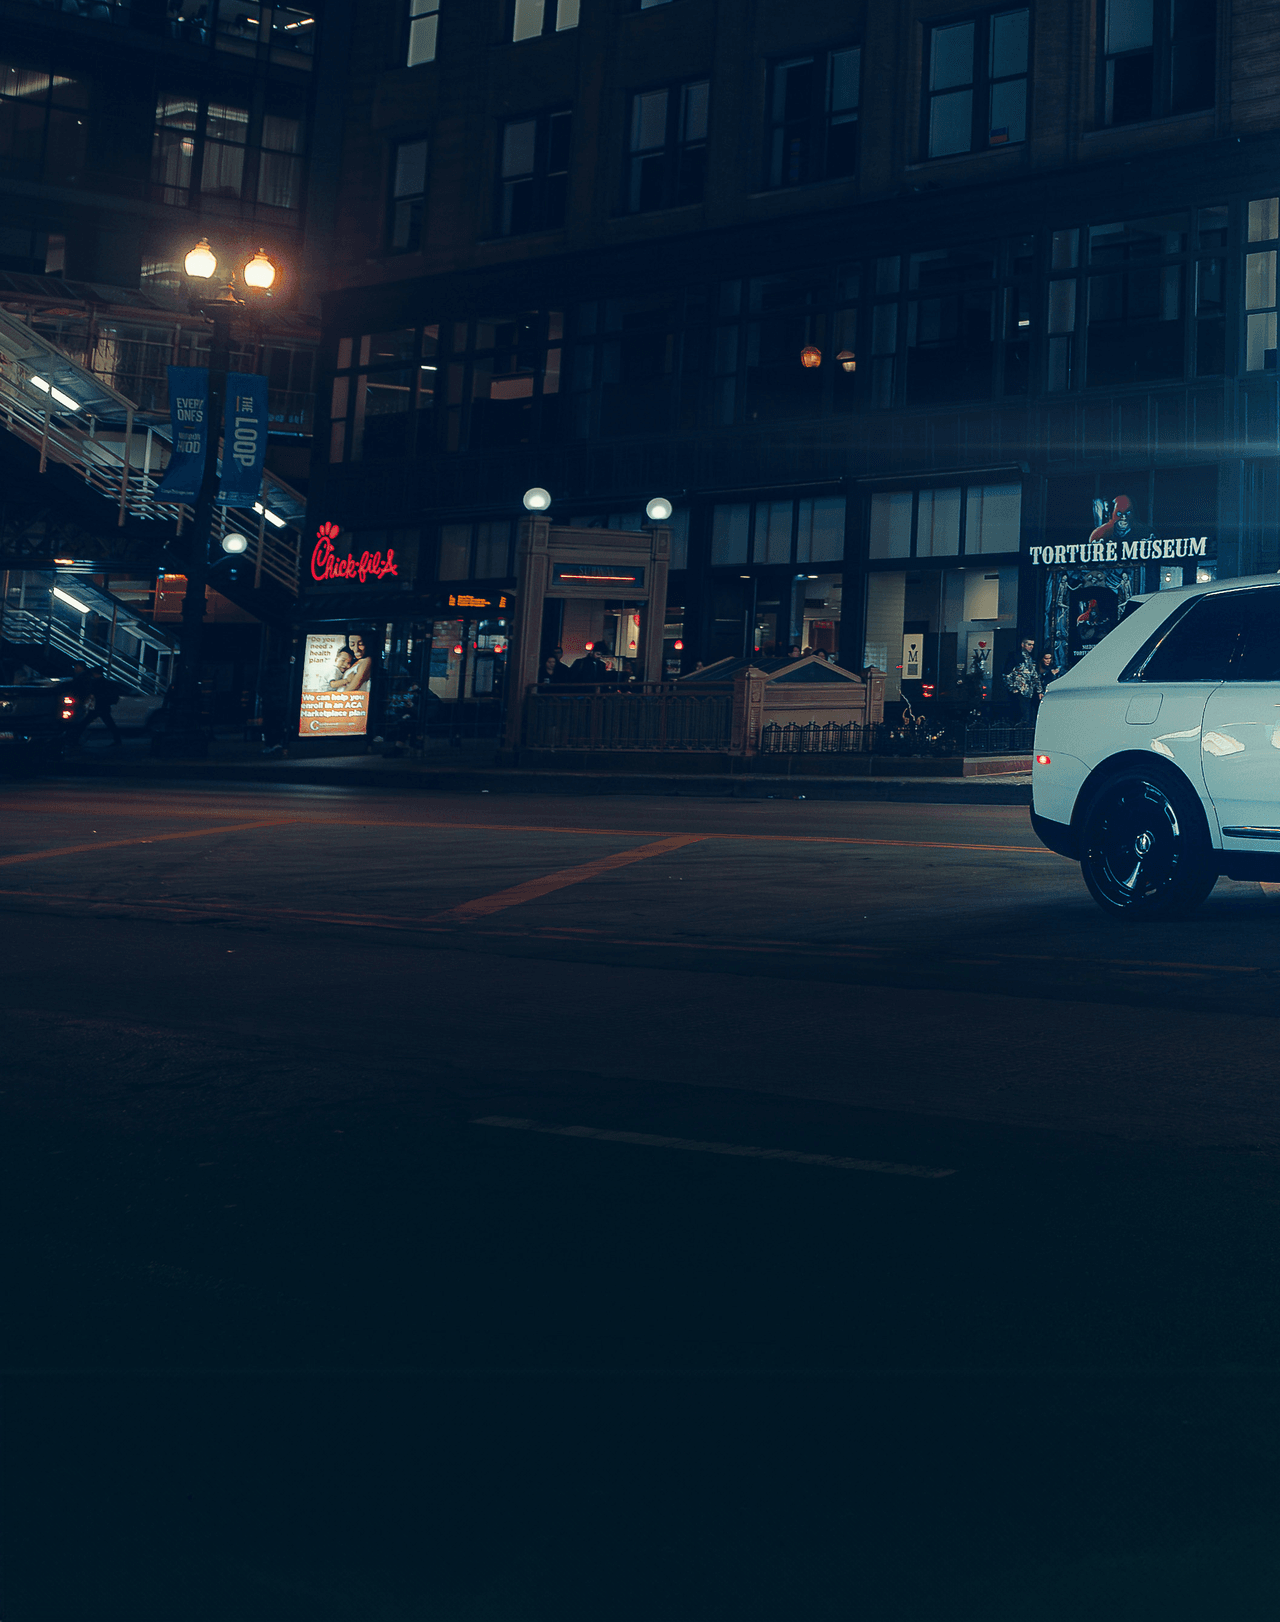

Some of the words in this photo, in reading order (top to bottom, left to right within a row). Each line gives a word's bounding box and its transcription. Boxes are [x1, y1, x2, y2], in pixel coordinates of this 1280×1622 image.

[242, 396, 253, 413] THE
[233, 417, 258, 467] LOOP
[311, 521, 398, 583] Chick-fil-A
[1030, 541, 1118, 565] TORTURE
[1121, 536, 1207, 561] MUSEUM
[331, 693, 348, 702] help
[349, 694, 365, 702] you
[300, 710, 347, 718] Marketplace
[348, 709, 366, 717] plan
